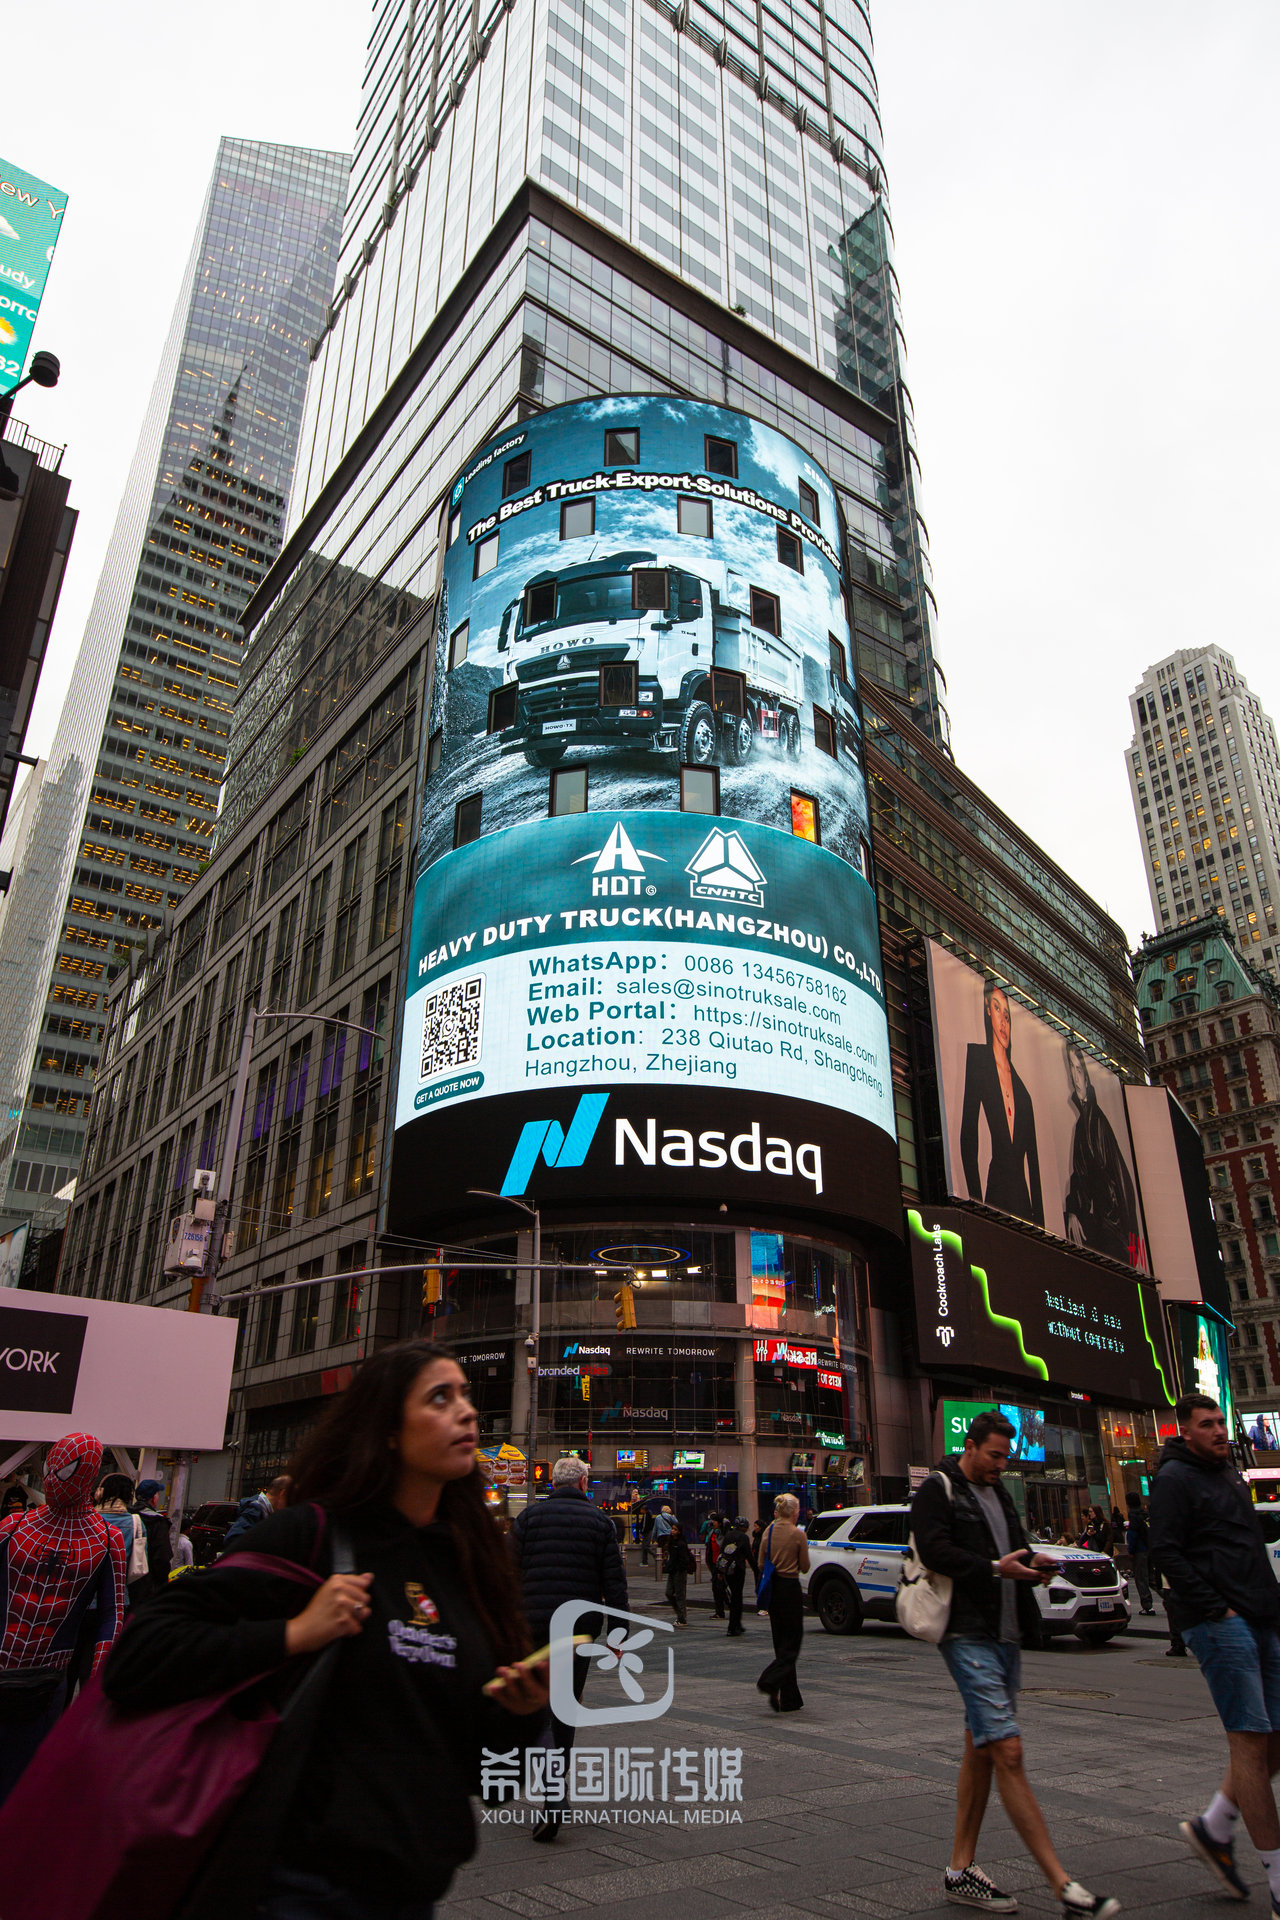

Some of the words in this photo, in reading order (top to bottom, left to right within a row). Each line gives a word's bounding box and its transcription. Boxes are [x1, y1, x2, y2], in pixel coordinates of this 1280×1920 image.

[465, 454, 492, 484] Leading
[493, 434, 525, 458] factory
[468, 515, 497, 543] The
[500, 489, 542, 522] Best
[546, 472, 788, 523] Truck-Export-Solutions
[791, 512, 842, 572] Provider
[540, 636, 595, 655] HOWO
[592, 876, 647, 897] HDT
[696, 886, 760, 903] CNHTC
[418, 932, 477, 977] HEAVY
[483, 914, 552, 946] DUTY
[560, 906, 829, 959] TRUCK(HANGZHOU)
[684, 955, 734, 975] 0086
[742, 961, 848, 1006] 13456758162
[529, 977, 602, 1002] Email:
[616, 977, 842, 1026] sales@sinotruksale.com
[527, 1004, 580, 1026] Web
[694, 1005, 878, 1068] https://sinotruksale.com/
[527, 1026, 643, 1051] Location:
[661, 1028, 701, 1046] 238
[709, 1031, 774, 1054] Qiutao
[780, 1041, 808, 1065] Rd,
[525, 1054, 638, 1077] Hangzhou,
[646, 1053, 738, 1080] Zhejiang
[416, 1092, 429, 1105] GET
[429, 1090, 434, 1100] A
[434, 1082, 459, 1098] QUOTE
[460, 1076, 480, 1090] NOW
[615, 1118, 824, 1196] Nasdaq
[931, 1224, 943, 1252] Labs
[934, 1253, 949, 1317] Cockroach
[579, 1345, 611, 1356] Nasdaq
[626, 1347, 664, 1355] REWRITE
[668, 1347, 716, 1356] TOMORROW
[623, 1405, 669, 1421] Nasdaq
